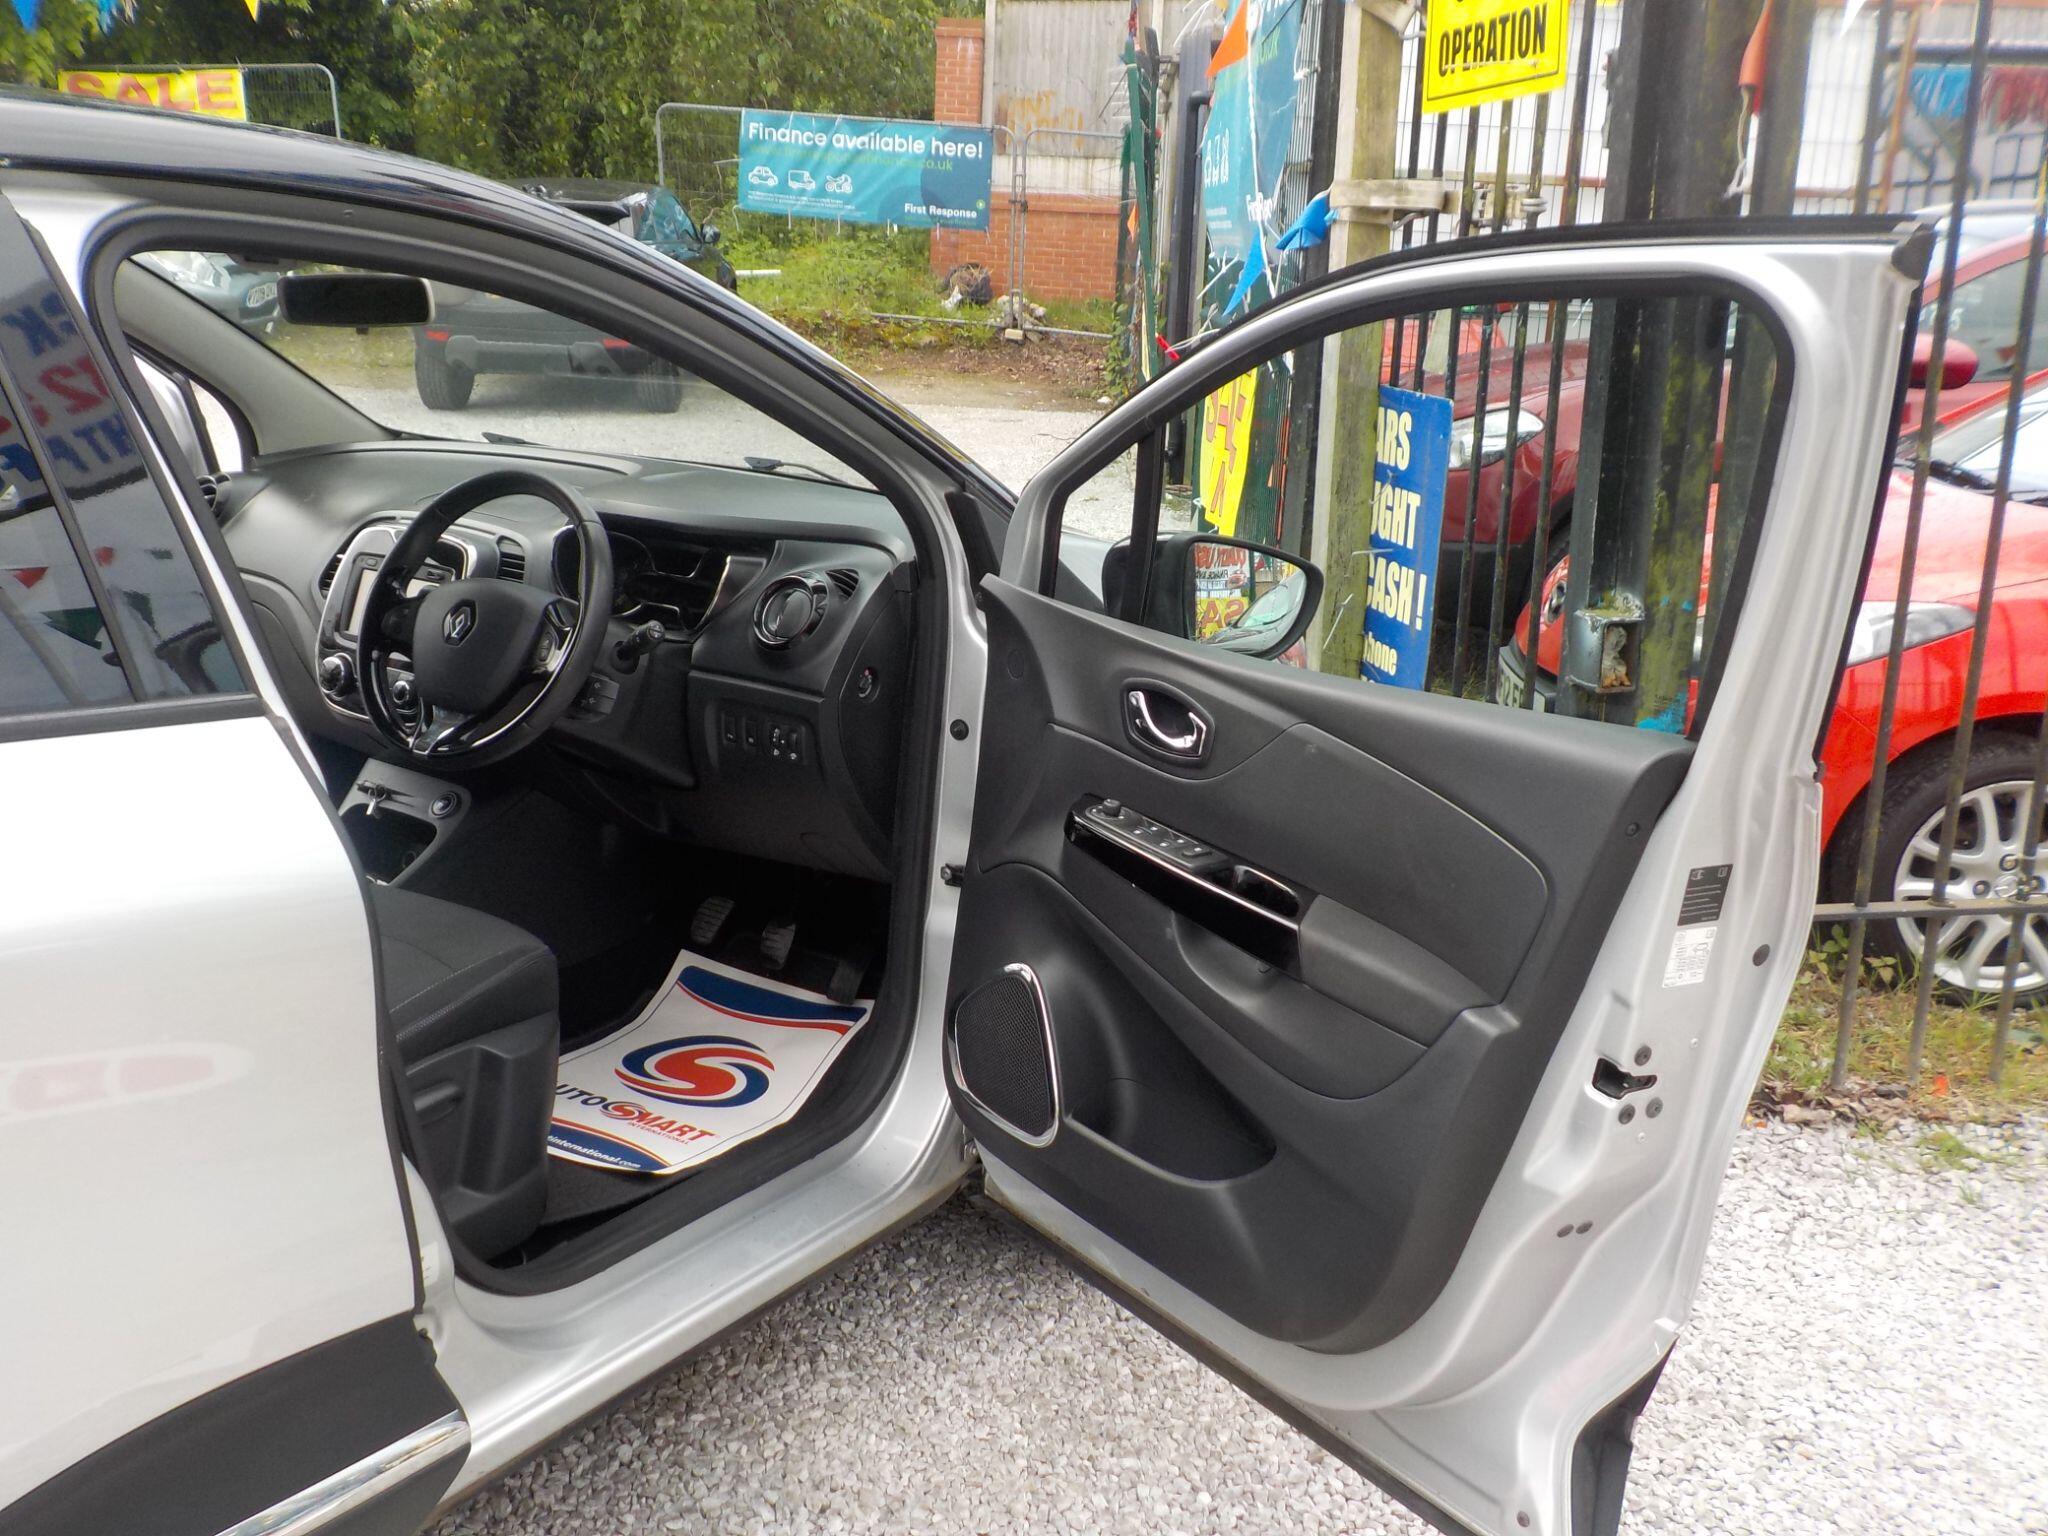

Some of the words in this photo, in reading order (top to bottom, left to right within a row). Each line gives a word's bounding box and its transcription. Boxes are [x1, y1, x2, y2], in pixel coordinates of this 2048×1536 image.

[1438, 3, 1547, 77] OPERATION
[749, 122, 827, 146] Finance
[832, 134, 925, 154] available
[931, 137, 983, 158] here!
[904, 203, 926, 214] First
[929, 205, 977, 218] Response
[627, 1121, 689, 1145] INTERNATIONAL
